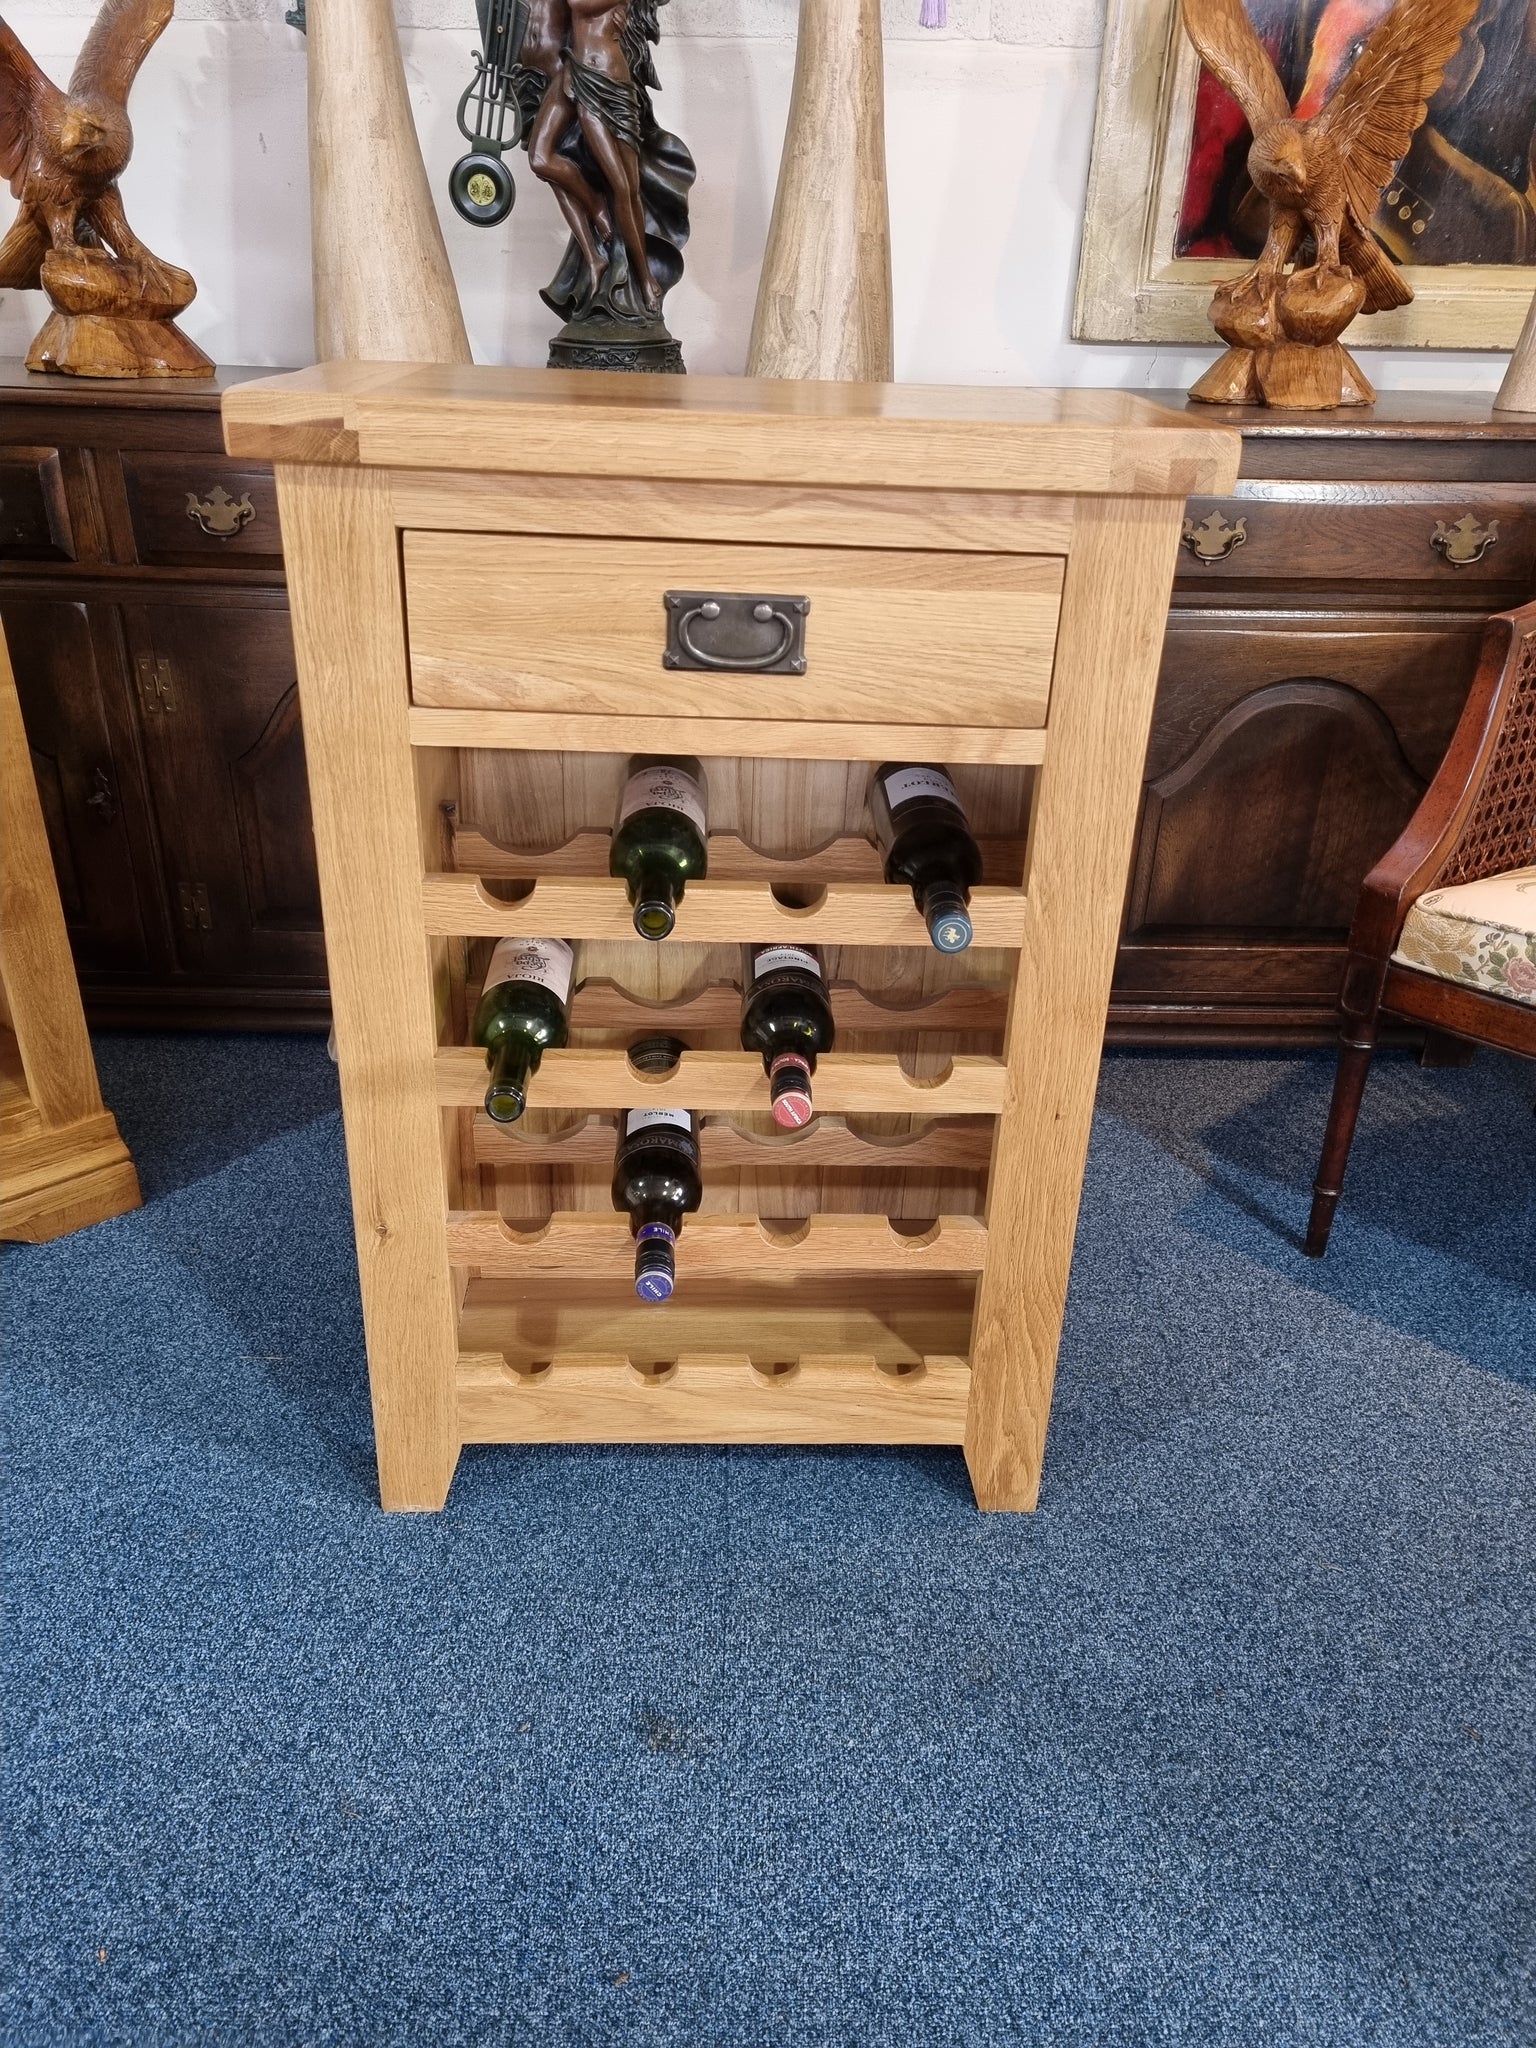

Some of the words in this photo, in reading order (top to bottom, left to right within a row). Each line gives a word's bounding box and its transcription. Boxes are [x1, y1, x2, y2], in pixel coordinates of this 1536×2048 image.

[767, 956, 808, 965] PINOTAGE
[506, 973, 545, 983] RIOJA
[645, 1280, 663, 1297] CHILE
